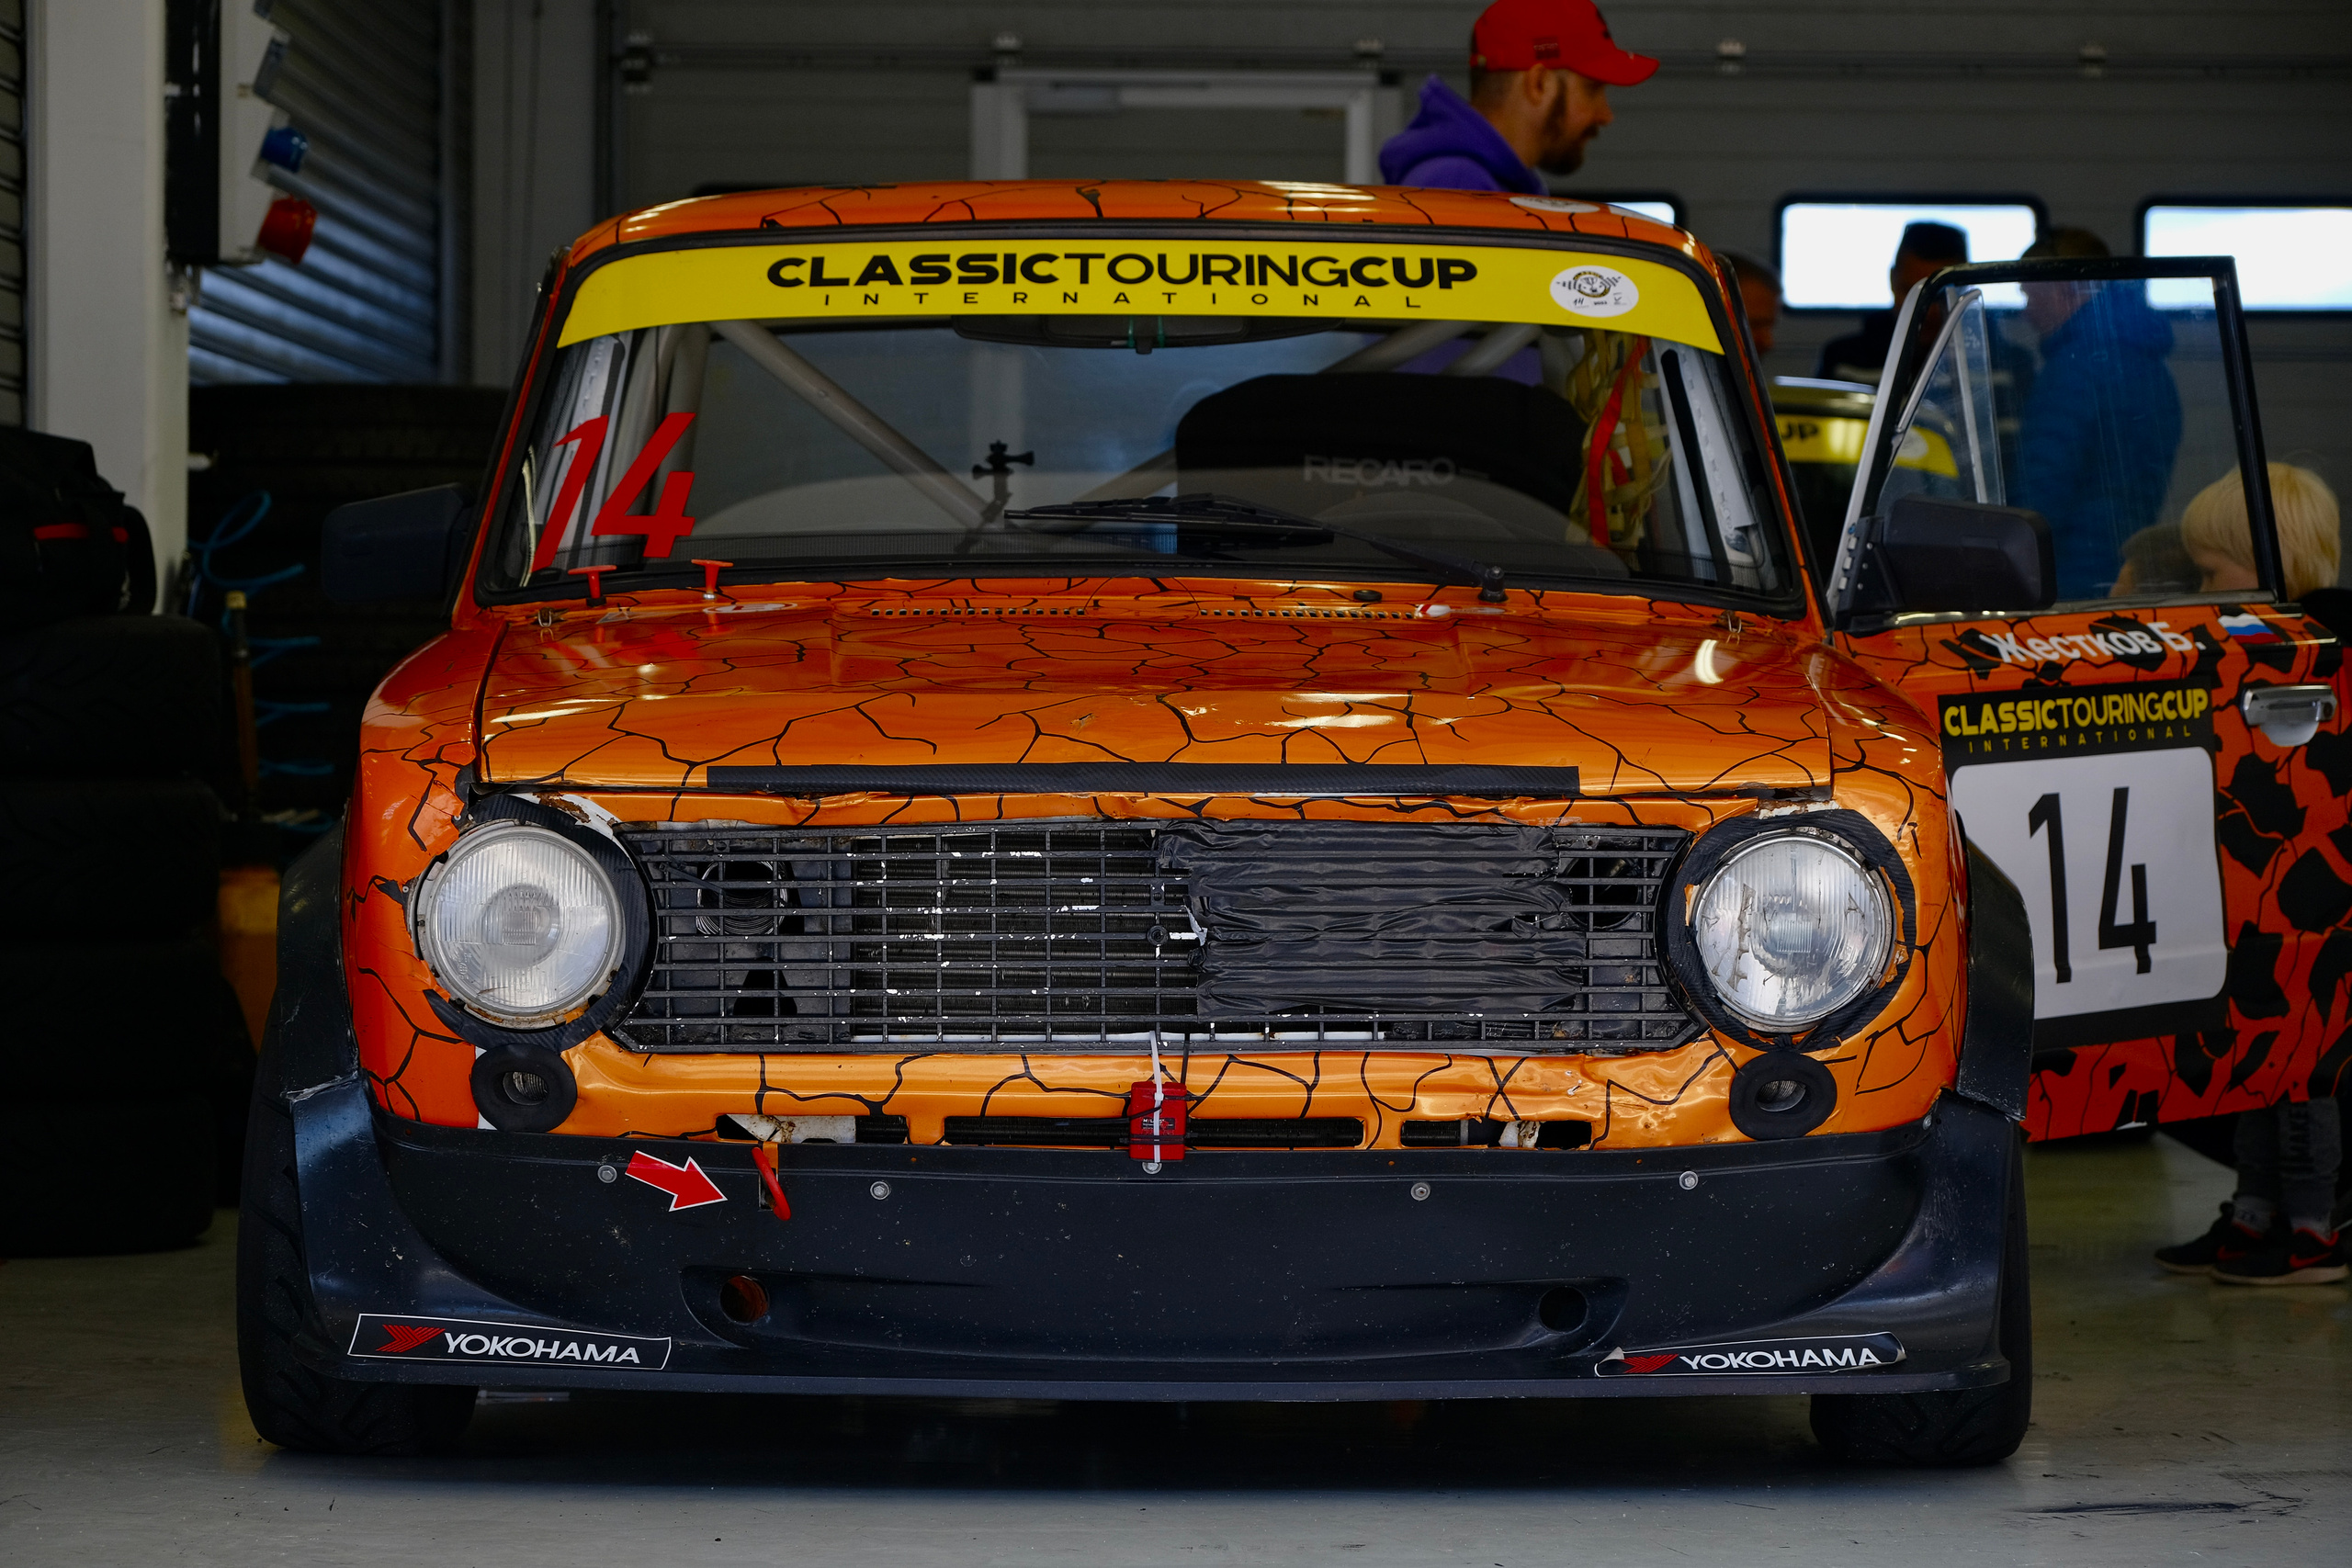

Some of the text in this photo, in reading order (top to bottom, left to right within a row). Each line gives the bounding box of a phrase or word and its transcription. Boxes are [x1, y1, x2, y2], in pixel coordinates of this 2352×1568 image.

[765, 253, 1477, 289] CLASSICTOURINGCUP
[825, 291, 1421, 309] INTERNATIONAL
[1303, 454, 1456, 486] RECARO
[530, 412, 696, 572] 14
[1980, 629, 2162, 663] Жестков
[1944, 687, 2209, 737] CLASSICTOURINGCUP
[1968, 725, 2191, 753] INTERNATIONAL
[2029, 786, 2157, 985] 14
[445, 1332, 641, 1364] YOKOHAMA
[1679, 1347, 1883, 1371] YOKOHAMA
